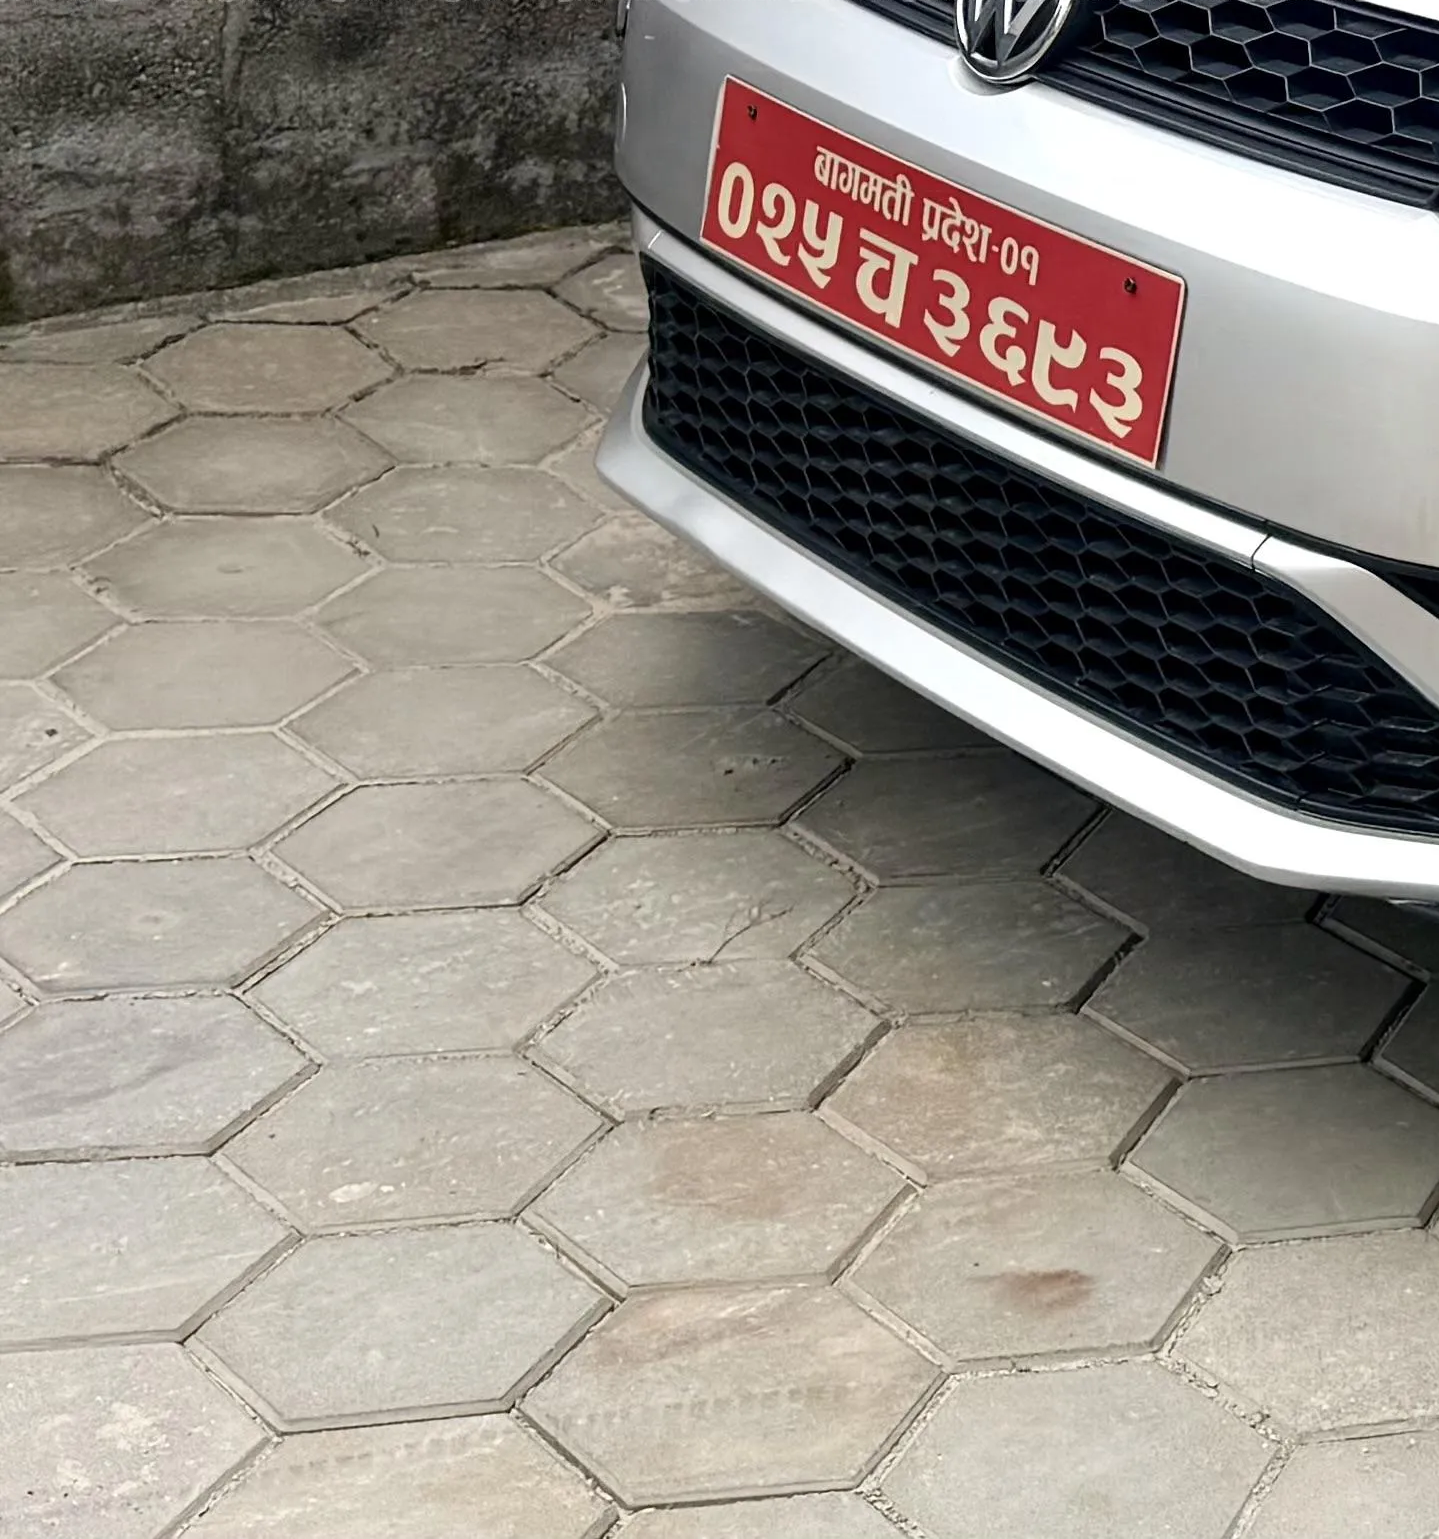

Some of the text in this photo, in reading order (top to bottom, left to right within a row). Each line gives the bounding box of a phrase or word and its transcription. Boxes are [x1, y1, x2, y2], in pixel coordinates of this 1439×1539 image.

[813, 145, 1041, 287] बागमती प्रदेश-०१
[854, 227, 919, 329] च
